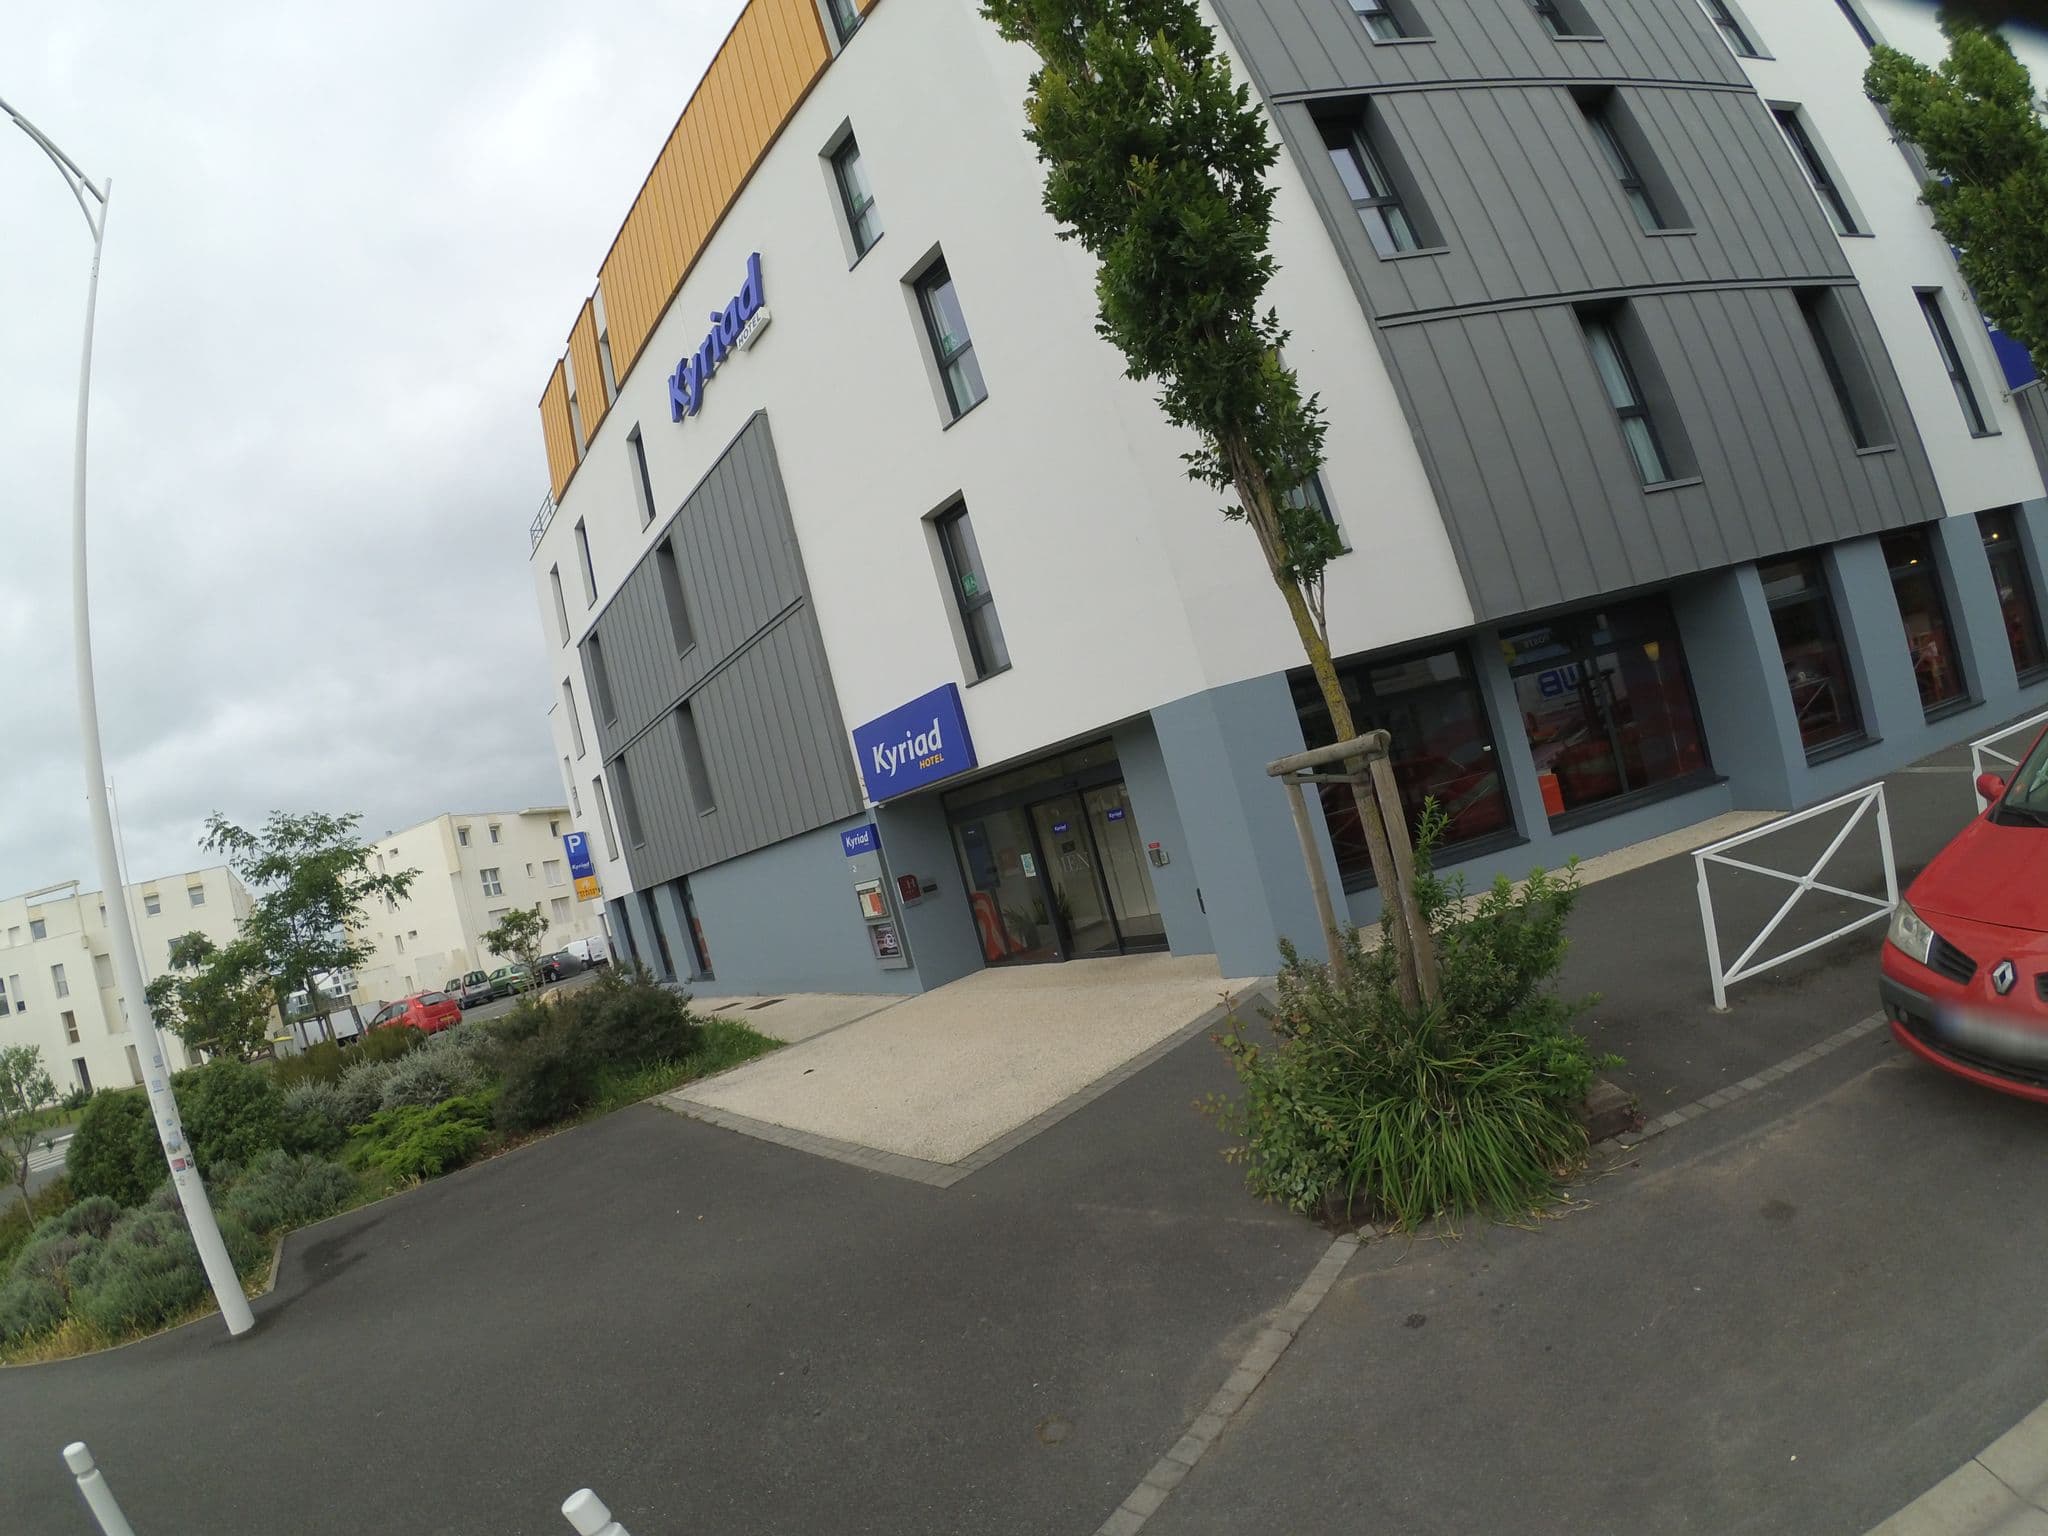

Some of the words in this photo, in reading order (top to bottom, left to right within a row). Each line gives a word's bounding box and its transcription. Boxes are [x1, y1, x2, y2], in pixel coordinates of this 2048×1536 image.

[668, 252, 764, 422] Kyriad
[737, 313, 762, 347] HOTEL
[872, 718, 942, 777] Kyriad
[919, 753, 945, 769] HOTEL
[567, 834, 581, 853] P
[846, 830, 869, 849] Kyriad
